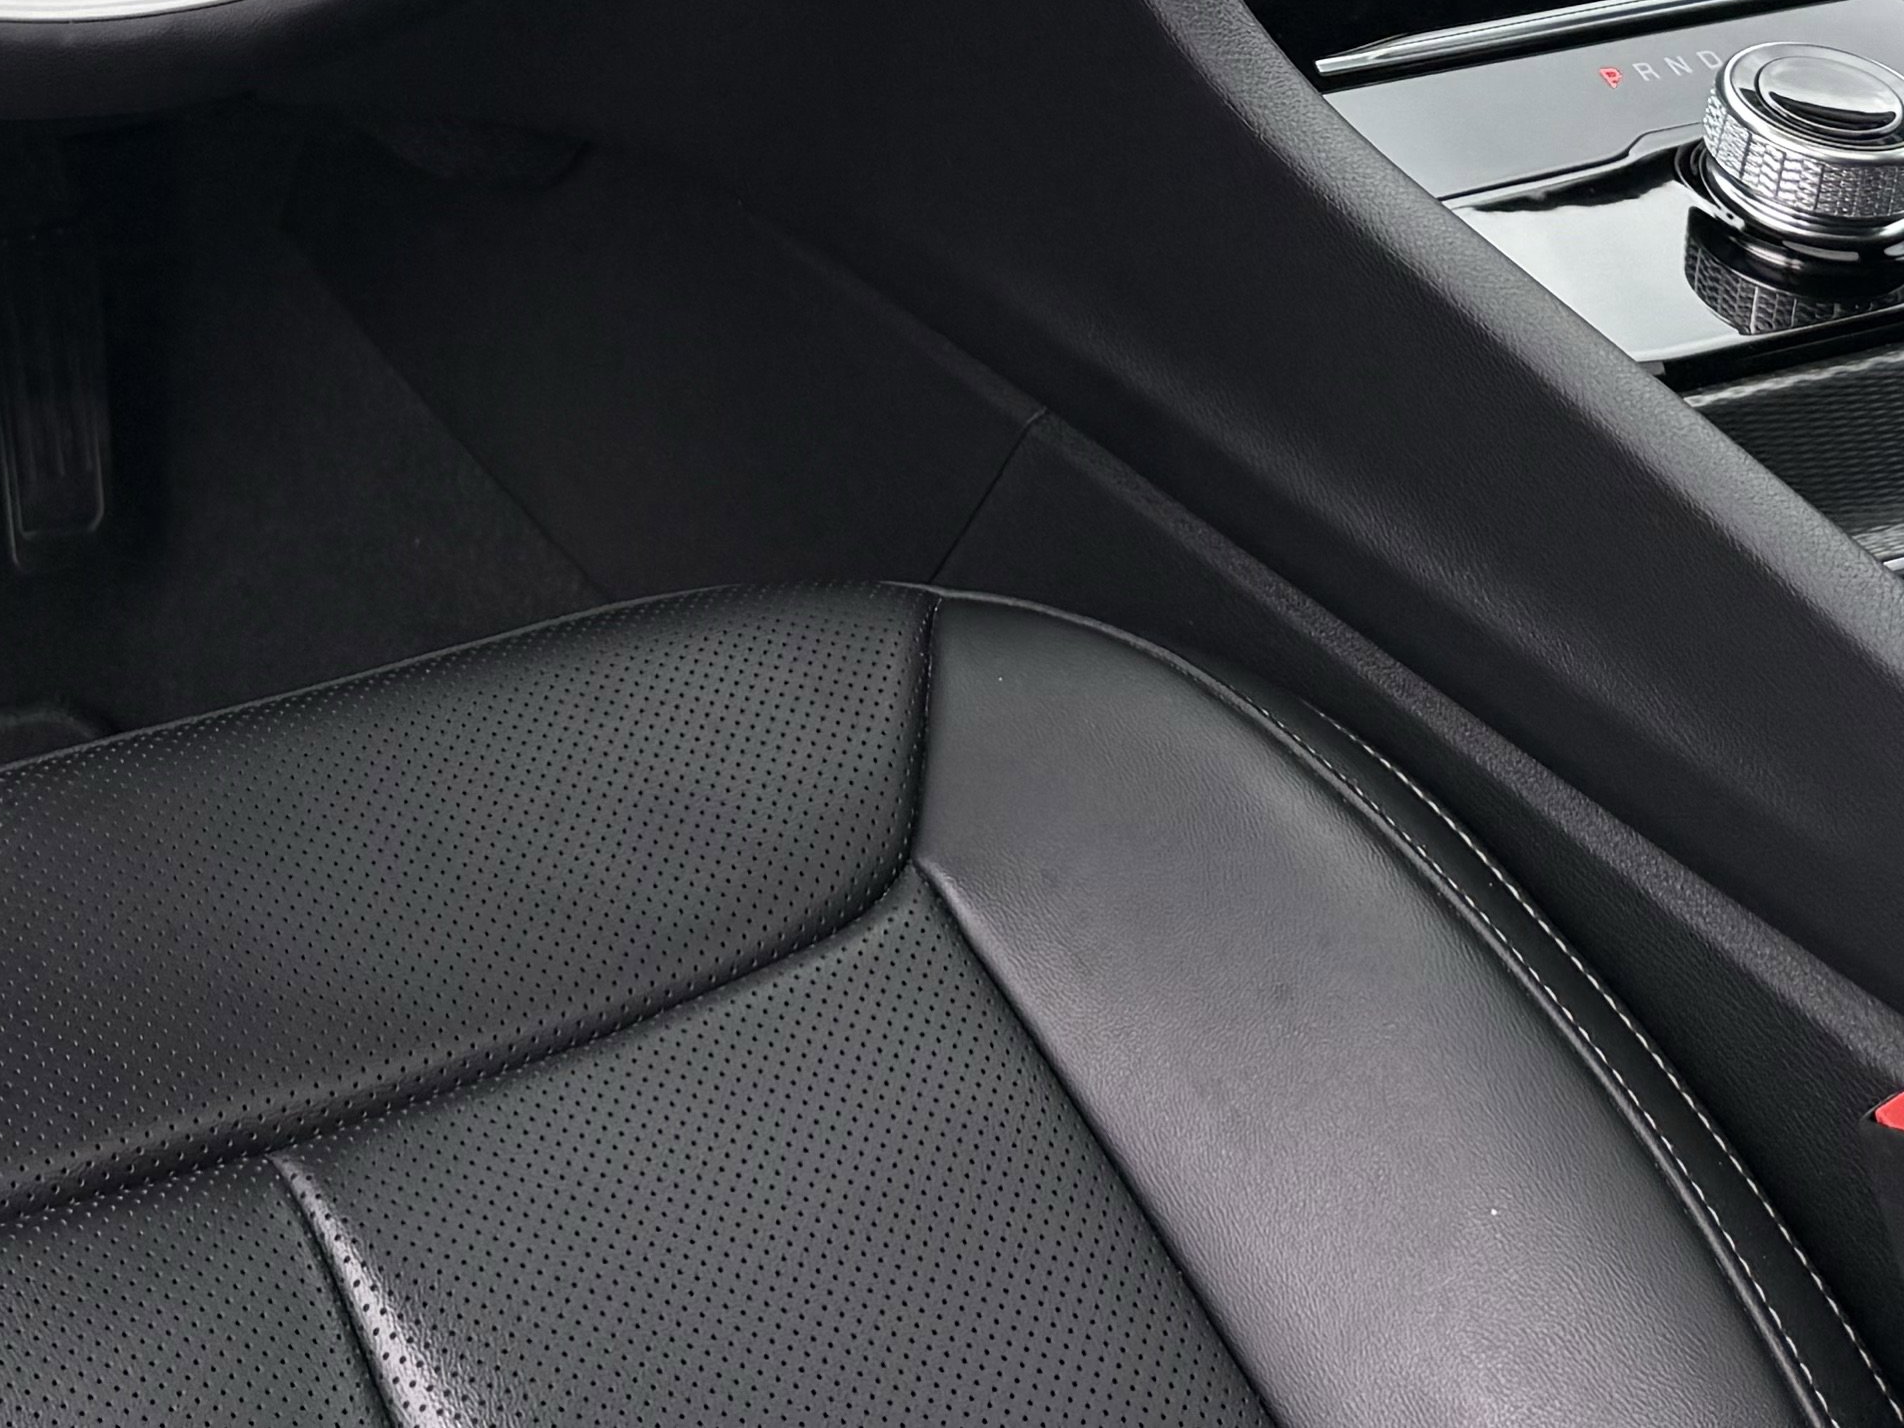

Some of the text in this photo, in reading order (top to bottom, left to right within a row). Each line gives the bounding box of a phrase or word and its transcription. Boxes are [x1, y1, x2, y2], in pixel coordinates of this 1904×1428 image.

[1632, 62, 1661, 82] R
[1663, 55, 1693, 76] N
[1696, 50, 1723, 70] D
